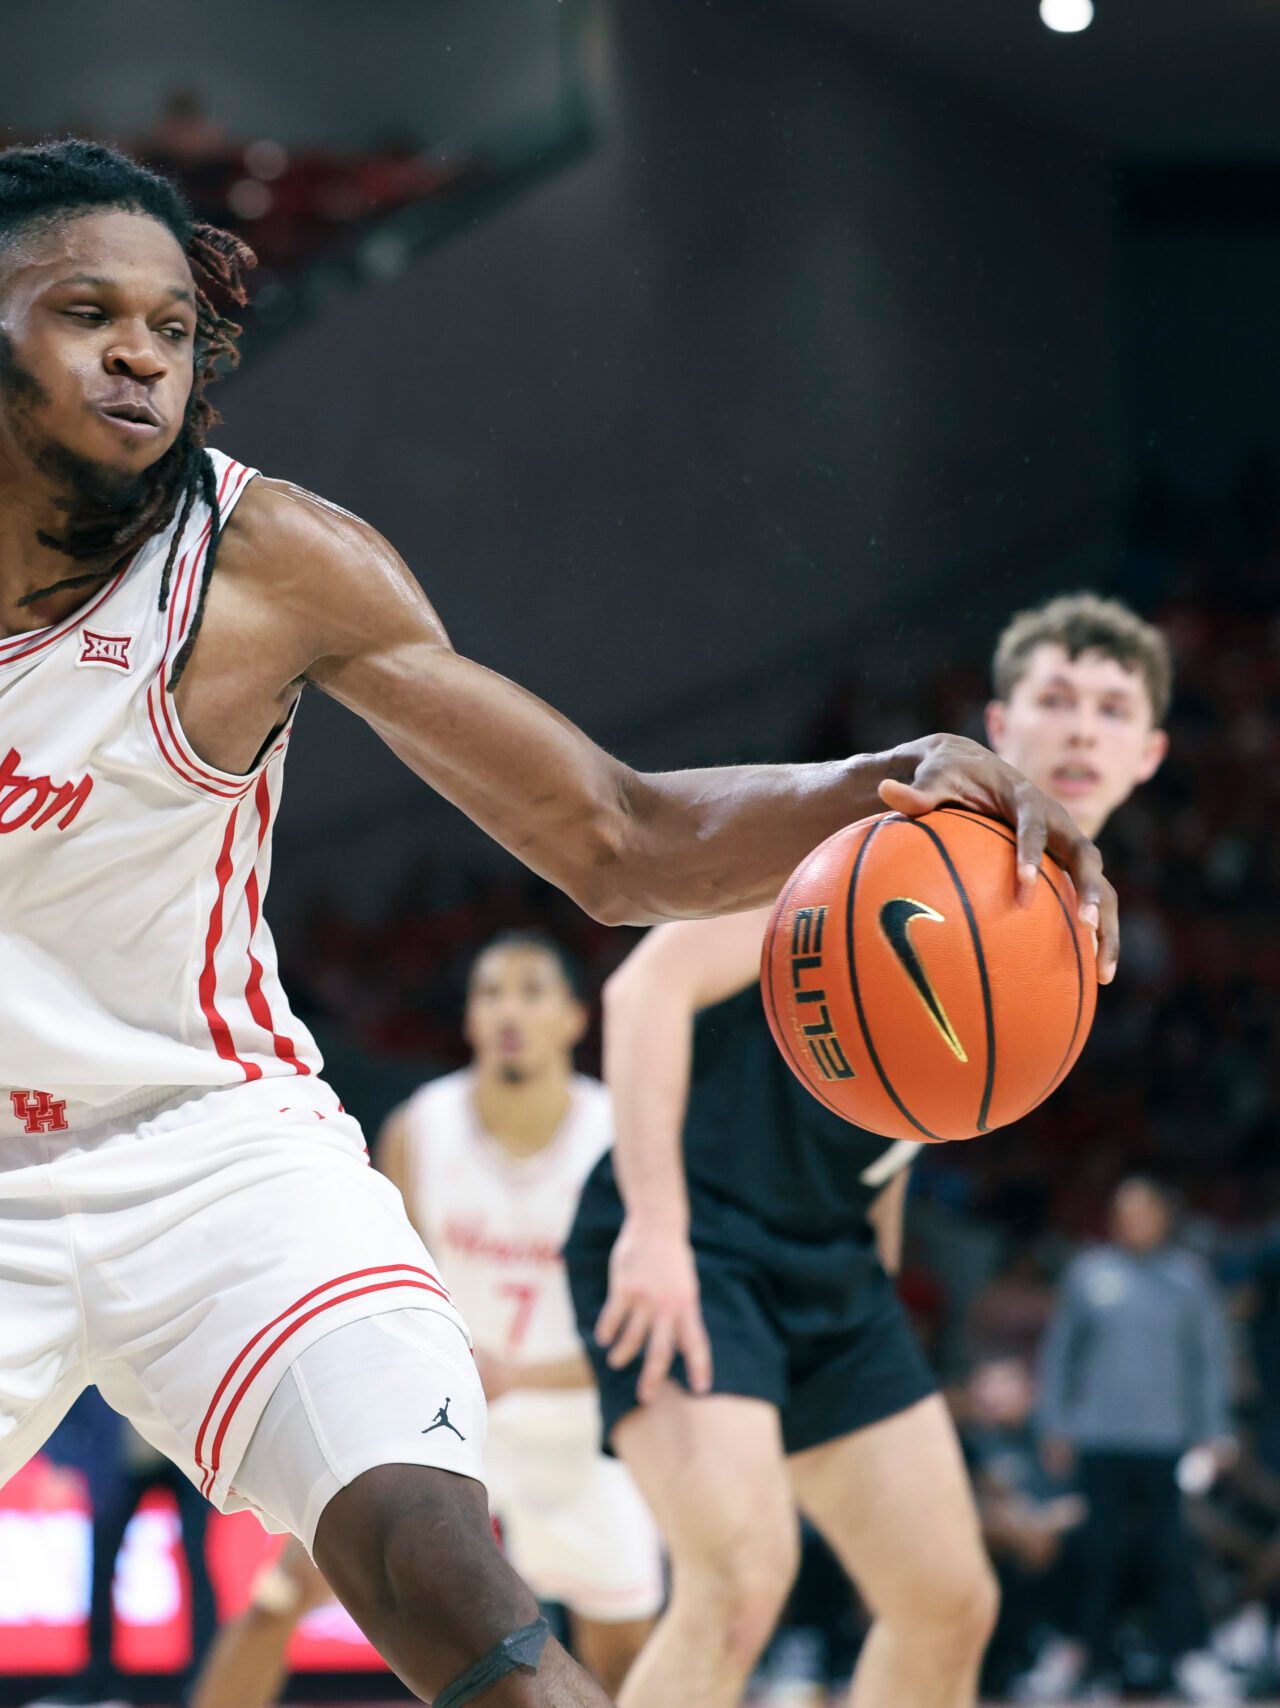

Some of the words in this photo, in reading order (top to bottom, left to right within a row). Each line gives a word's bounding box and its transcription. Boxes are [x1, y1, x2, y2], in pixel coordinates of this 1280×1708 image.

[792, 905, 856, 1080] ELITE
[10, 1090, 68, 1133] UH
[494, 1281, 539, 1350] 7
